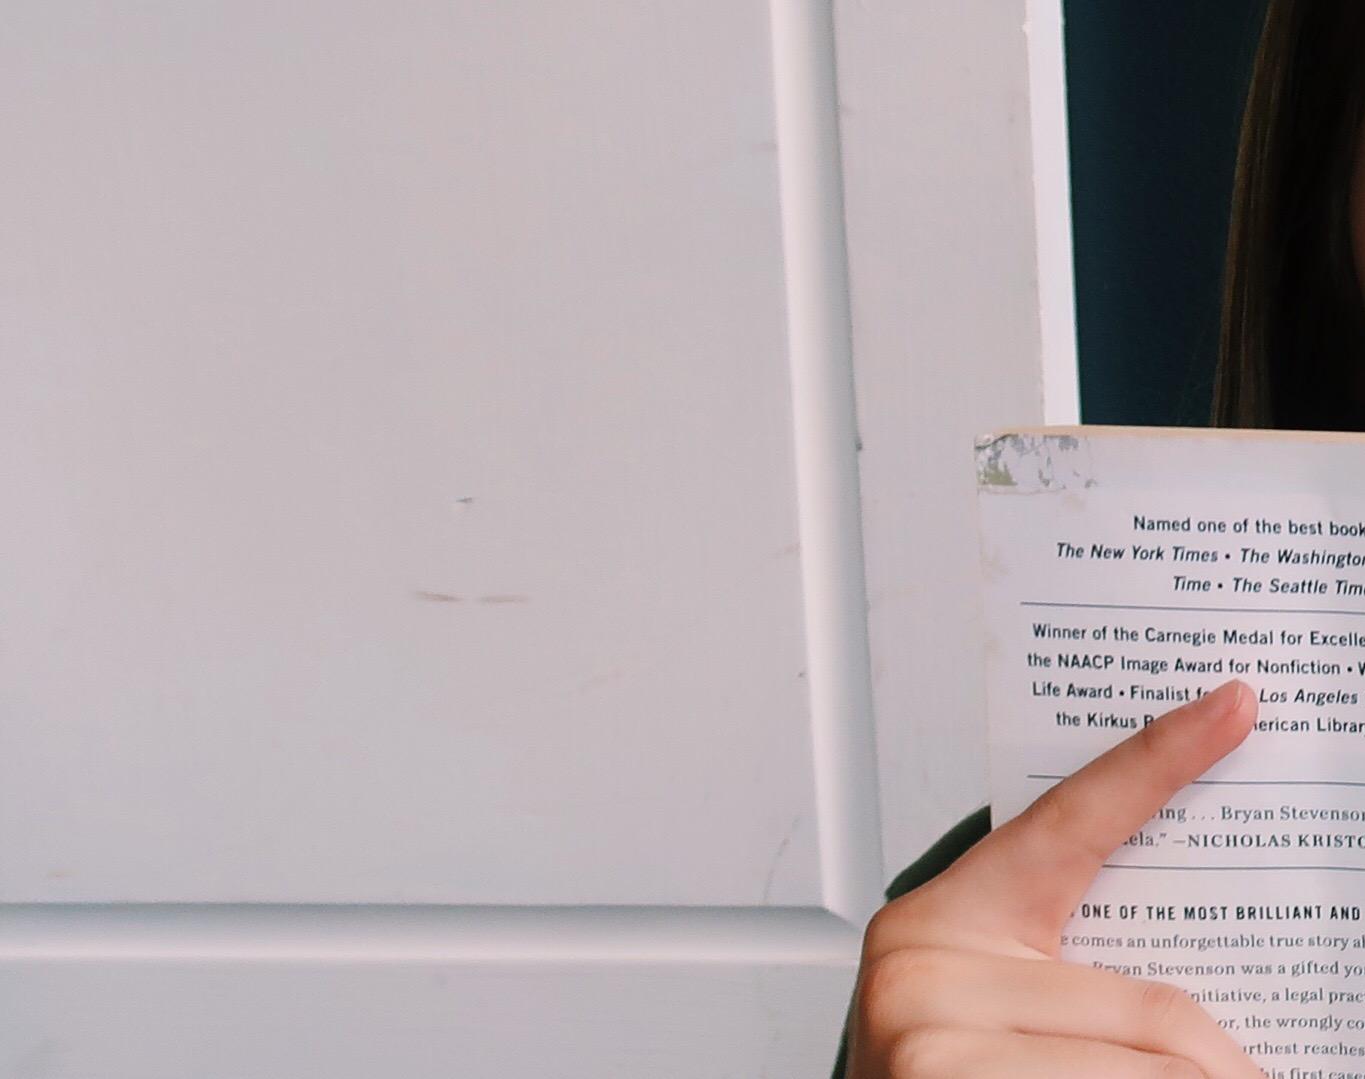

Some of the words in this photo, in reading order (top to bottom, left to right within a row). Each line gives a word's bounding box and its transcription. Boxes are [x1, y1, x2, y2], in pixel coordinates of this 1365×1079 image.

[1133, 515, 1191, 532] Named
[1196, 520, 1227, 533] one
[1232, 517, 1249, 533] of
[1255, 519, 1282, 535] the
[1288, 519, 1324, 536] best
[1056, 543, 1085, 559] The
[1090, 543, 1126, 560] New
[1132, 544, 1165, 561] York
[1172, 545, 1219, 562] Times
[1240, 547, 1271, 564] The
[1173, 576, 1212, 592] Time
[1232, 576, 1263, 592] The
[1269, 577, 1328, 595] Seattle
[1032, 623, 1087, 640] Winner
[1092, 625, 1108, 640] of
[1113, 627, 1139, 642] the
[1144, 626, 1217, 646] Carnegie
[1223, 629, 1274, 646] Medal
[1279, 629, 1304, 646] for
[1027, 653, 1052, 668] the
[1057, 653, 1115, 670] NAACP
[1120, 656, 1169, 675] Image
[1173, 657, 1223, 674] Award
[1228, 658, 1251, 674] for
[1256, 659, 1341, 675] Nonfiction
[1032, 682, 1061, 698] Life
[1066, 682, 1113, 699] Award
[1129, 685, 1191, 702] Finalist
[1259, 688, 1288, 704] Los
[1293, 689, 1358, 706] Angeles
[1055, 712, 1081, 727] the
[1086, 711, 1140, 728] Kirkus
[1253, 718, 1310, 732] erican
[1220, 805, 1275, 824] Bryan
[1081, 904, 1112, 919] ONE
[1119, 905, 1138, 920] OF
[1145, 905, 1177, 921] THE
[1183, 905, 1228, 921] MOST
[1235, 905, 1322, 920] BRILLIANT
[1329, 906, 1361, 921] AND
[1071, 936, 1123, 948] comes
[1126, 937, 1147, 949] an
[1150, 933, 1265, 952] unforgettable
[1268, 934, 1305, 947] true
[1307, 936, 1350, 951] story
[1147, 962, 1236, 975] Stevenson
[1240, 964, 1273, 974] was
[1277, 964, 1286, 974] a
[1291, 960, 1340, 978] gifted
[1271, 992, 1280, 1001] a
[1284, 986, 1324, 1005] legal
[1244, 1015, 1272, 1029] the
[1275, 1013, 1344, 1032] wrongly
[1303, 1041, 1365, 1057] reaches
